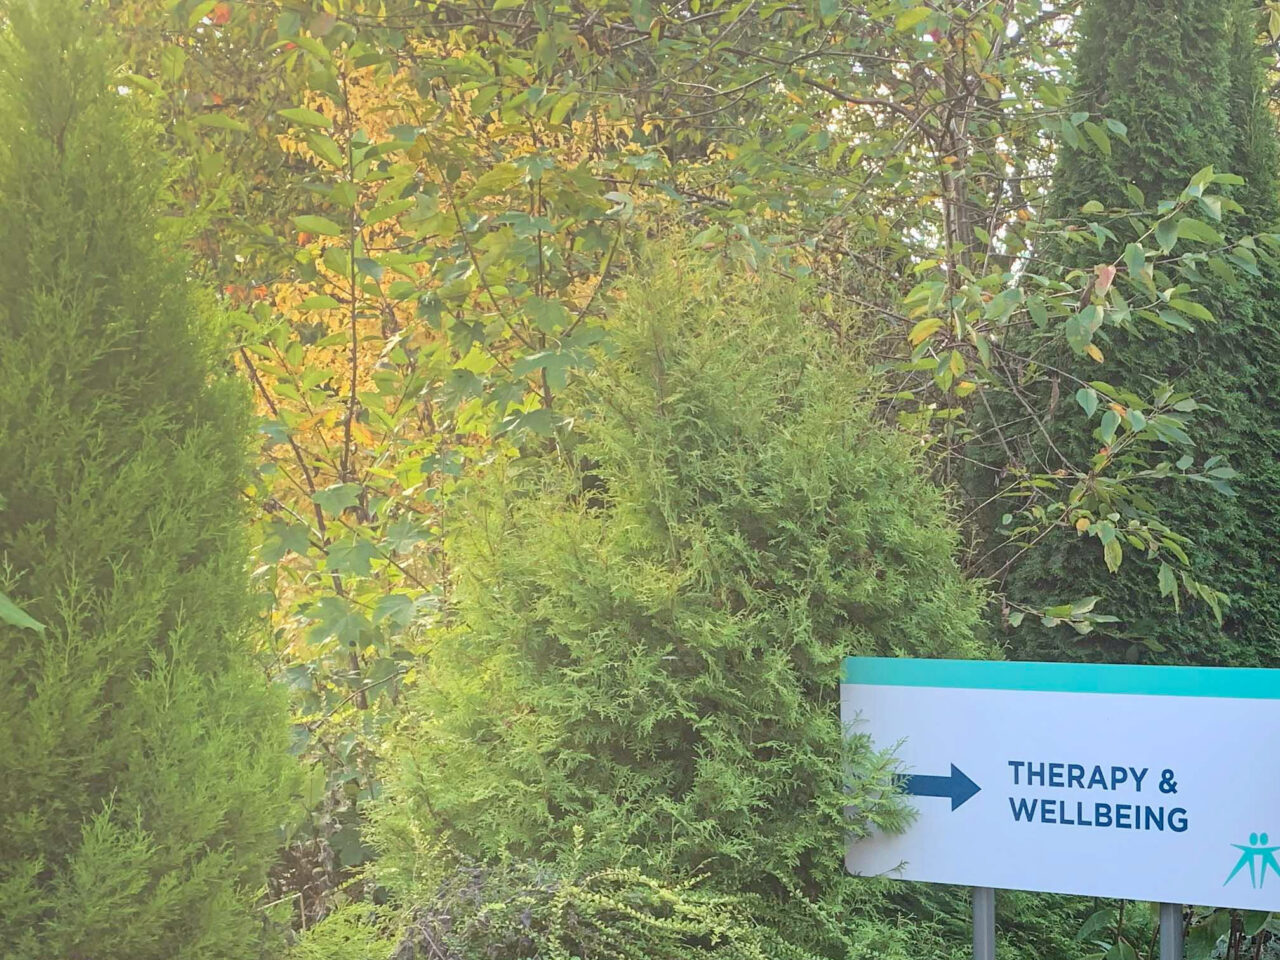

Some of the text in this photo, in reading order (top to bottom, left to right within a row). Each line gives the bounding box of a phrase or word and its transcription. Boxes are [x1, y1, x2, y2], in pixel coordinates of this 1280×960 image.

[1008, 760, 1178, 795] THERAPY &
[1008, 797, 1189, 833] WELLBEING
